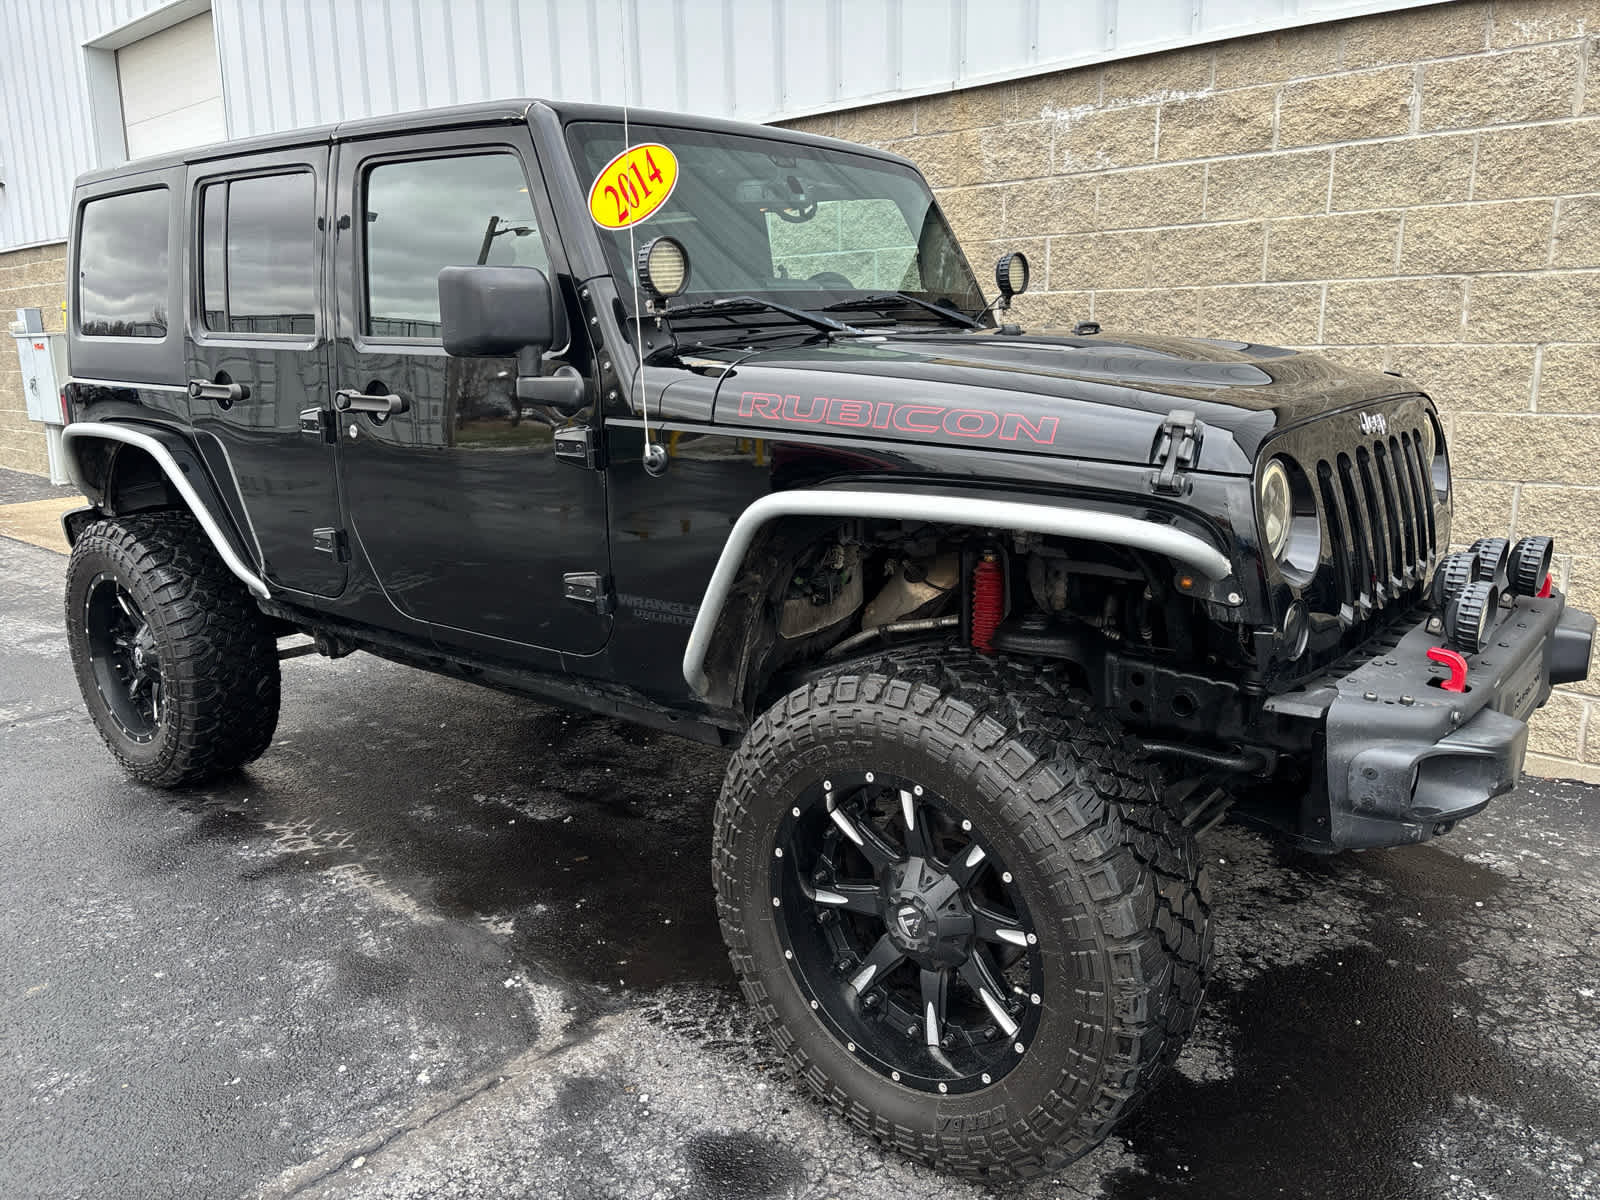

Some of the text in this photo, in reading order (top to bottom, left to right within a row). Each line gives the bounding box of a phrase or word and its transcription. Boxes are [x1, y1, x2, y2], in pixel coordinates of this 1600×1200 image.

[604, 149, 663, 223] 2014
[738, 392, 1060, 444] RUBICON
[616, 593, 699, 618] WRANGLE
[632, 609, 696, 624] UNLIMITE
